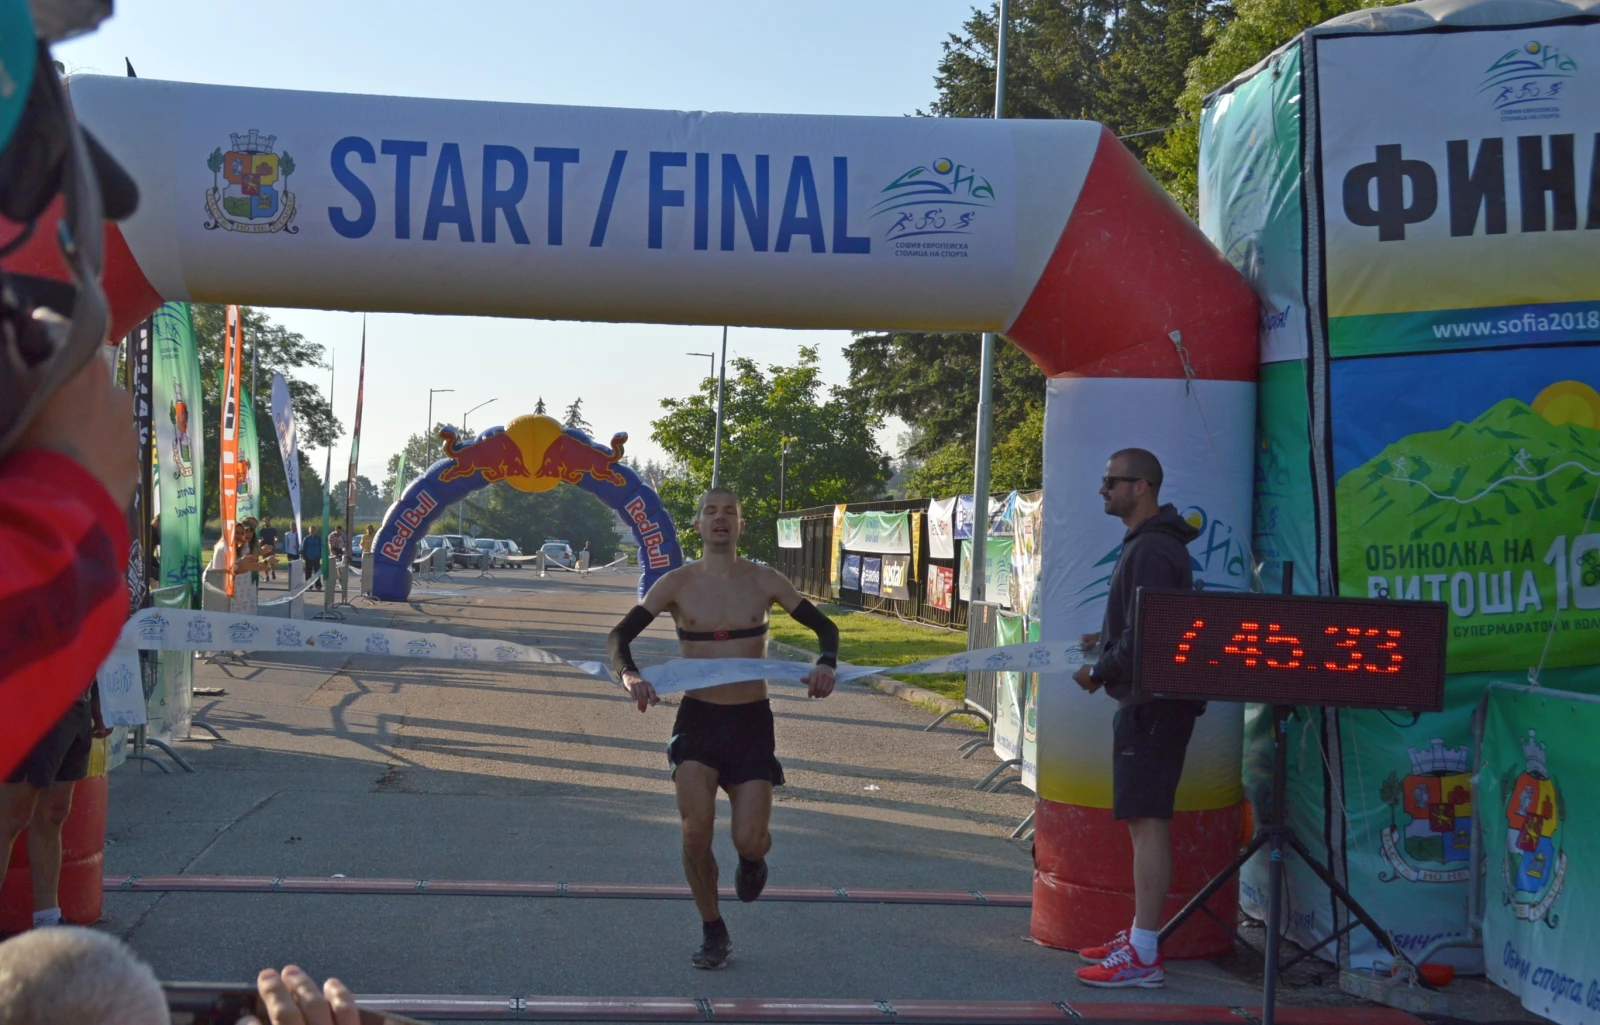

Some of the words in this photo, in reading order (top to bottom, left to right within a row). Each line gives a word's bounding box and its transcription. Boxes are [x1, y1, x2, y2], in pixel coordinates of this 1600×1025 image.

[328, 136, 579, 246] START
[647, 150, 872, 254] FINAL
[1342, 133, 1600, 242] ФИН
[380, 520, 414, 562] Red
[401, 489, 438, 529] Bull
[624, 496, 659, 535] Red
[643, 531, 671, 569] Bull
[1366, 540, 1494, 571] ОБИКОЛКА
[1504, 539, 1535, 564] НА
[1367, 570, 1544, 617] ВИТОША
[1453, 620, 1557, 638] СУПЕРМАРАТОН
[1574, 617, 1600, 630] КОЛ
